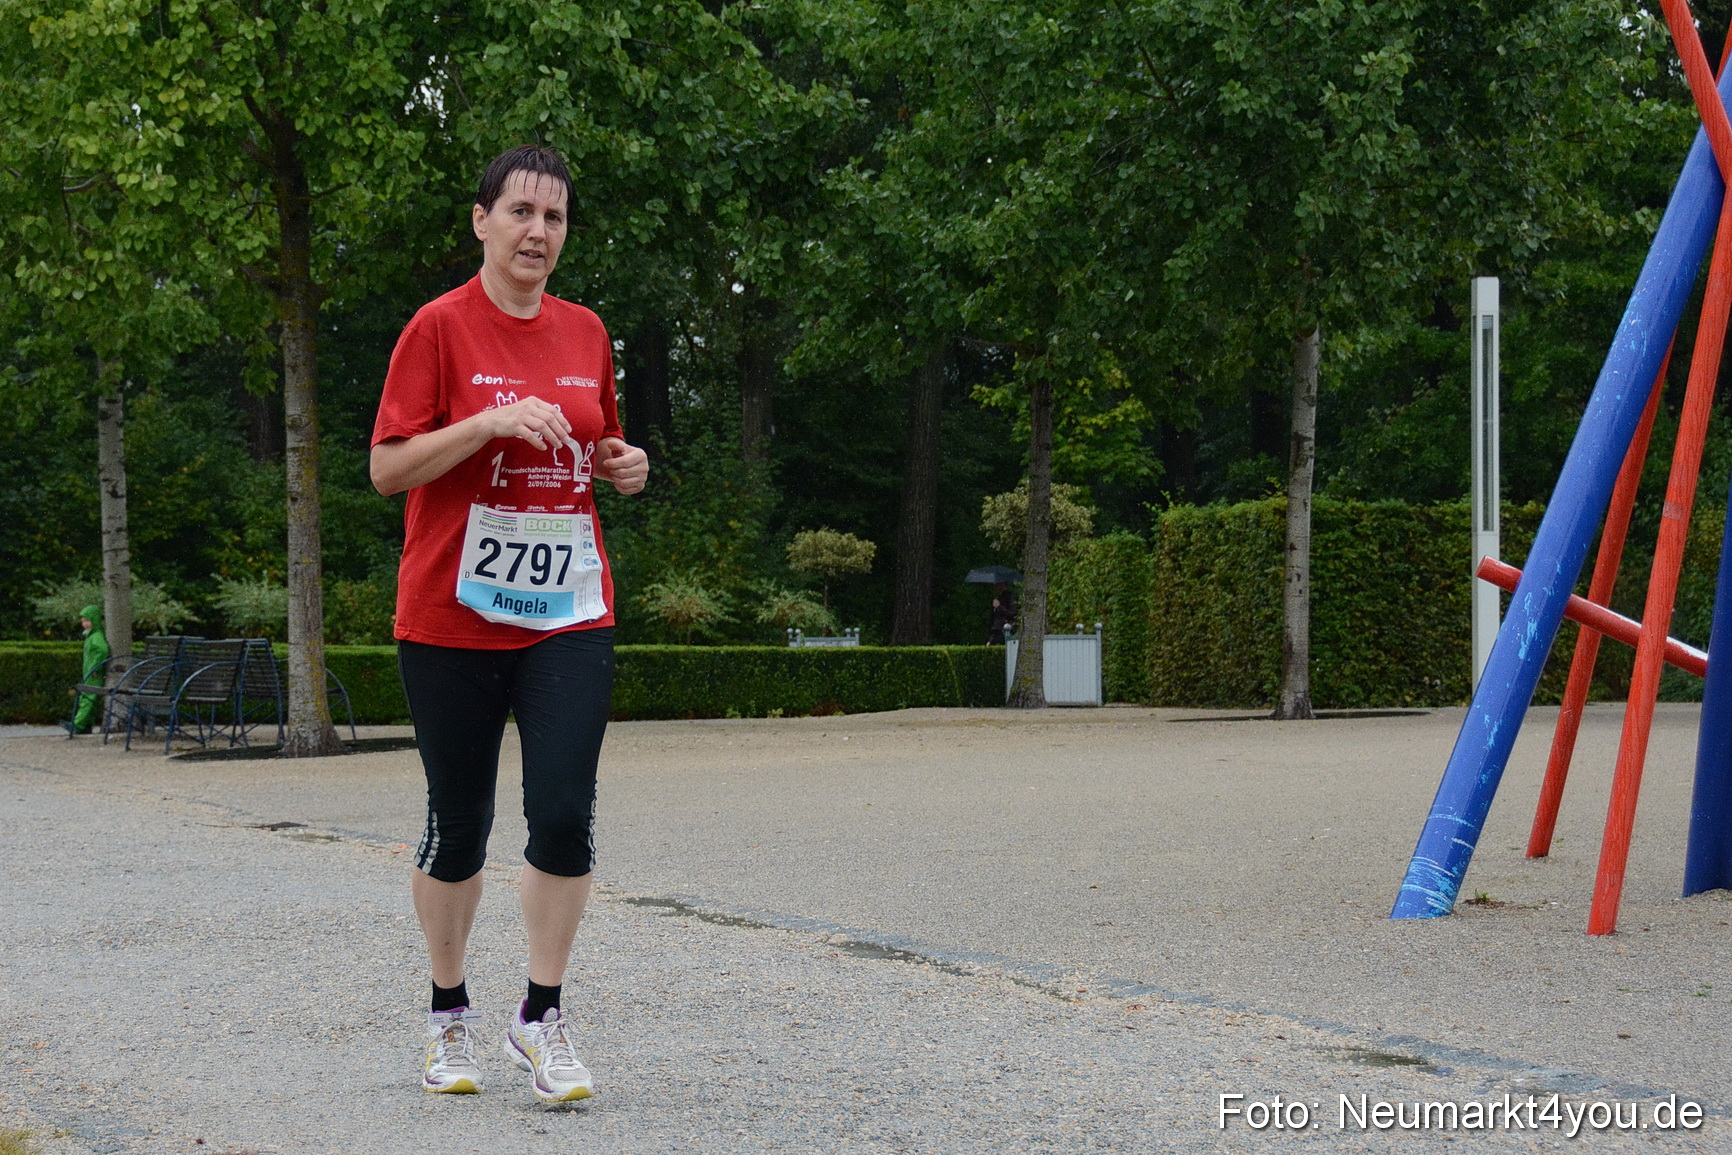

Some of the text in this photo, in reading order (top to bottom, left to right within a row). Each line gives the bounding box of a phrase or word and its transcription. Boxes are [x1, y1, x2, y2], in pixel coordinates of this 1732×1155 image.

[478, 519, 518, 533] NeuerMarkt
[524, 518, 573, 532] BOCK
[474, 537, 573, 586] 2797
[464, 571, 470, 579] D
[492, 592, 548, 615] Angela
